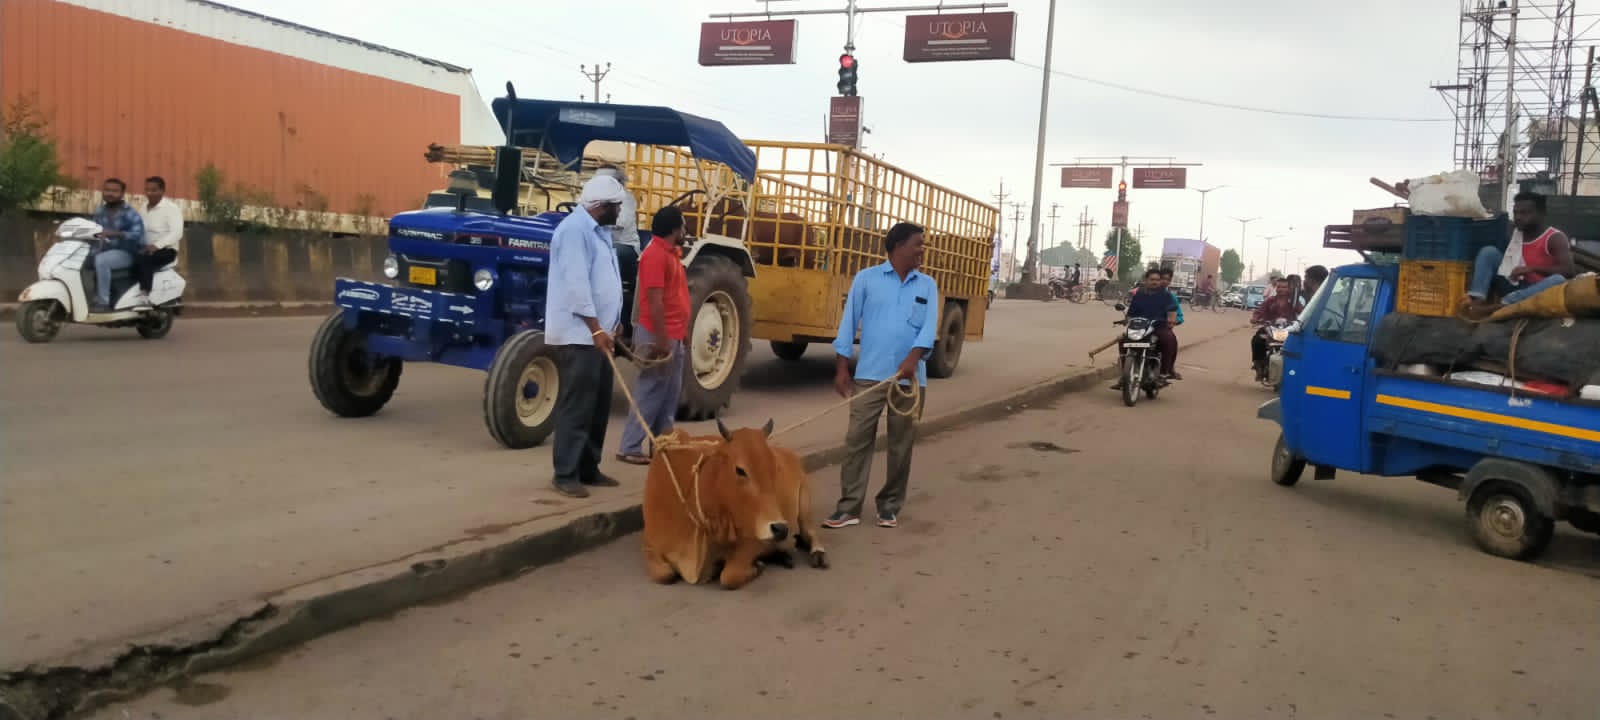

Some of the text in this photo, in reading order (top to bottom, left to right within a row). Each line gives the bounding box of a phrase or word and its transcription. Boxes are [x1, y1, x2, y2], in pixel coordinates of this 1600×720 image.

[721, 28, 771, 42] UTOPIA
[929, 21, 987, 37] UTOPIA
[508, 237, 551, 250] FARMTRA
